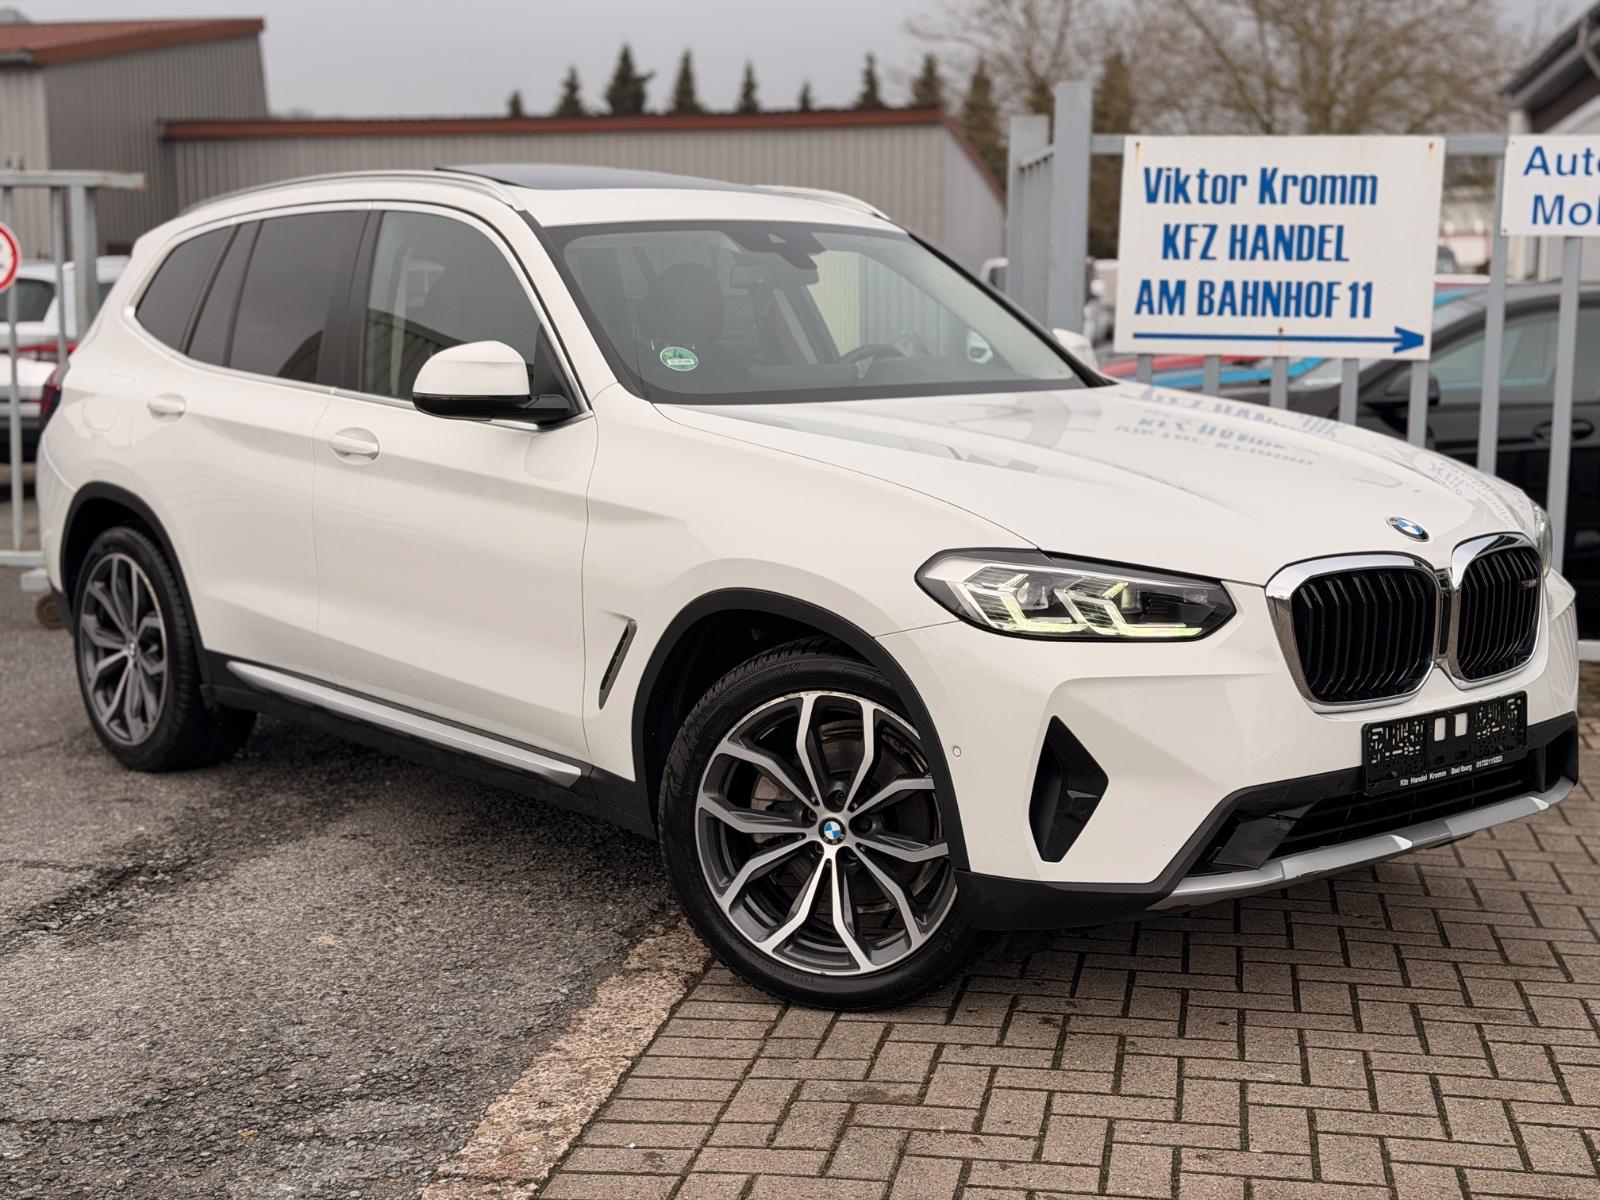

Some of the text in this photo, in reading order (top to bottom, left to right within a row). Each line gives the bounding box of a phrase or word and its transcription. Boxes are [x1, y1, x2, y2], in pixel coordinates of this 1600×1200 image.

[1523, 146, 1600, 176] Aut
[1144, 168, 1376, 205] Viktor Kromm
[1532, 195, 1600, 224] Mo
[1163, 224, 1349, 262] KFZ HANDEL
[1134, 279, 1373, 318] AM BAHNHOF 11
[1410, 774, 1428, 784] Handel
[1429, 771, 1447, 780] Kromm
[1451, 766, 1461, 775] Bad
